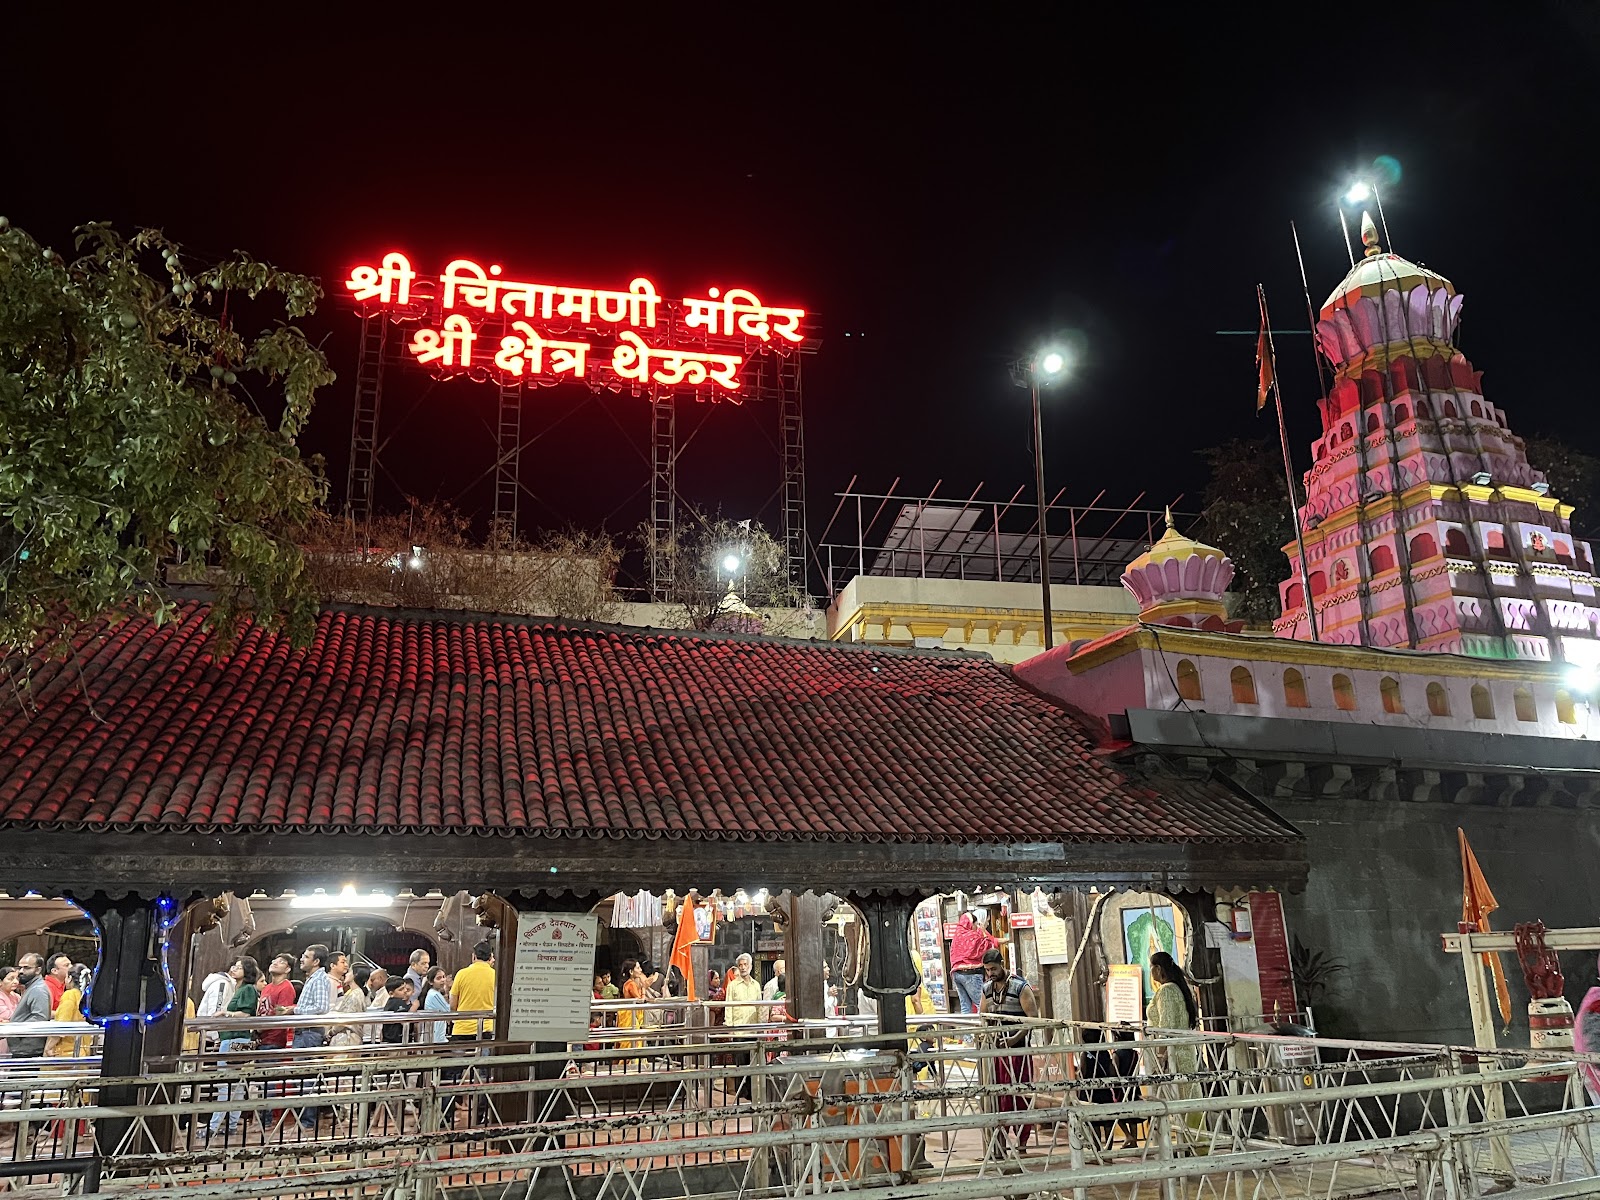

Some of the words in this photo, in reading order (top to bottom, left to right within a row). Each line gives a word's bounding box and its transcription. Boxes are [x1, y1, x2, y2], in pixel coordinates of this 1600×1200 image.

[345, 252, 416, 305] श्री
[440, 259, 662, 328] चिंतामणी
[683, 287, 805, 343] मंदिर
[408, 314, 478, 367] श्री
[494, 321, 591, 378] क्षेत्र
[612, 331, 743, 389] थेऊर
